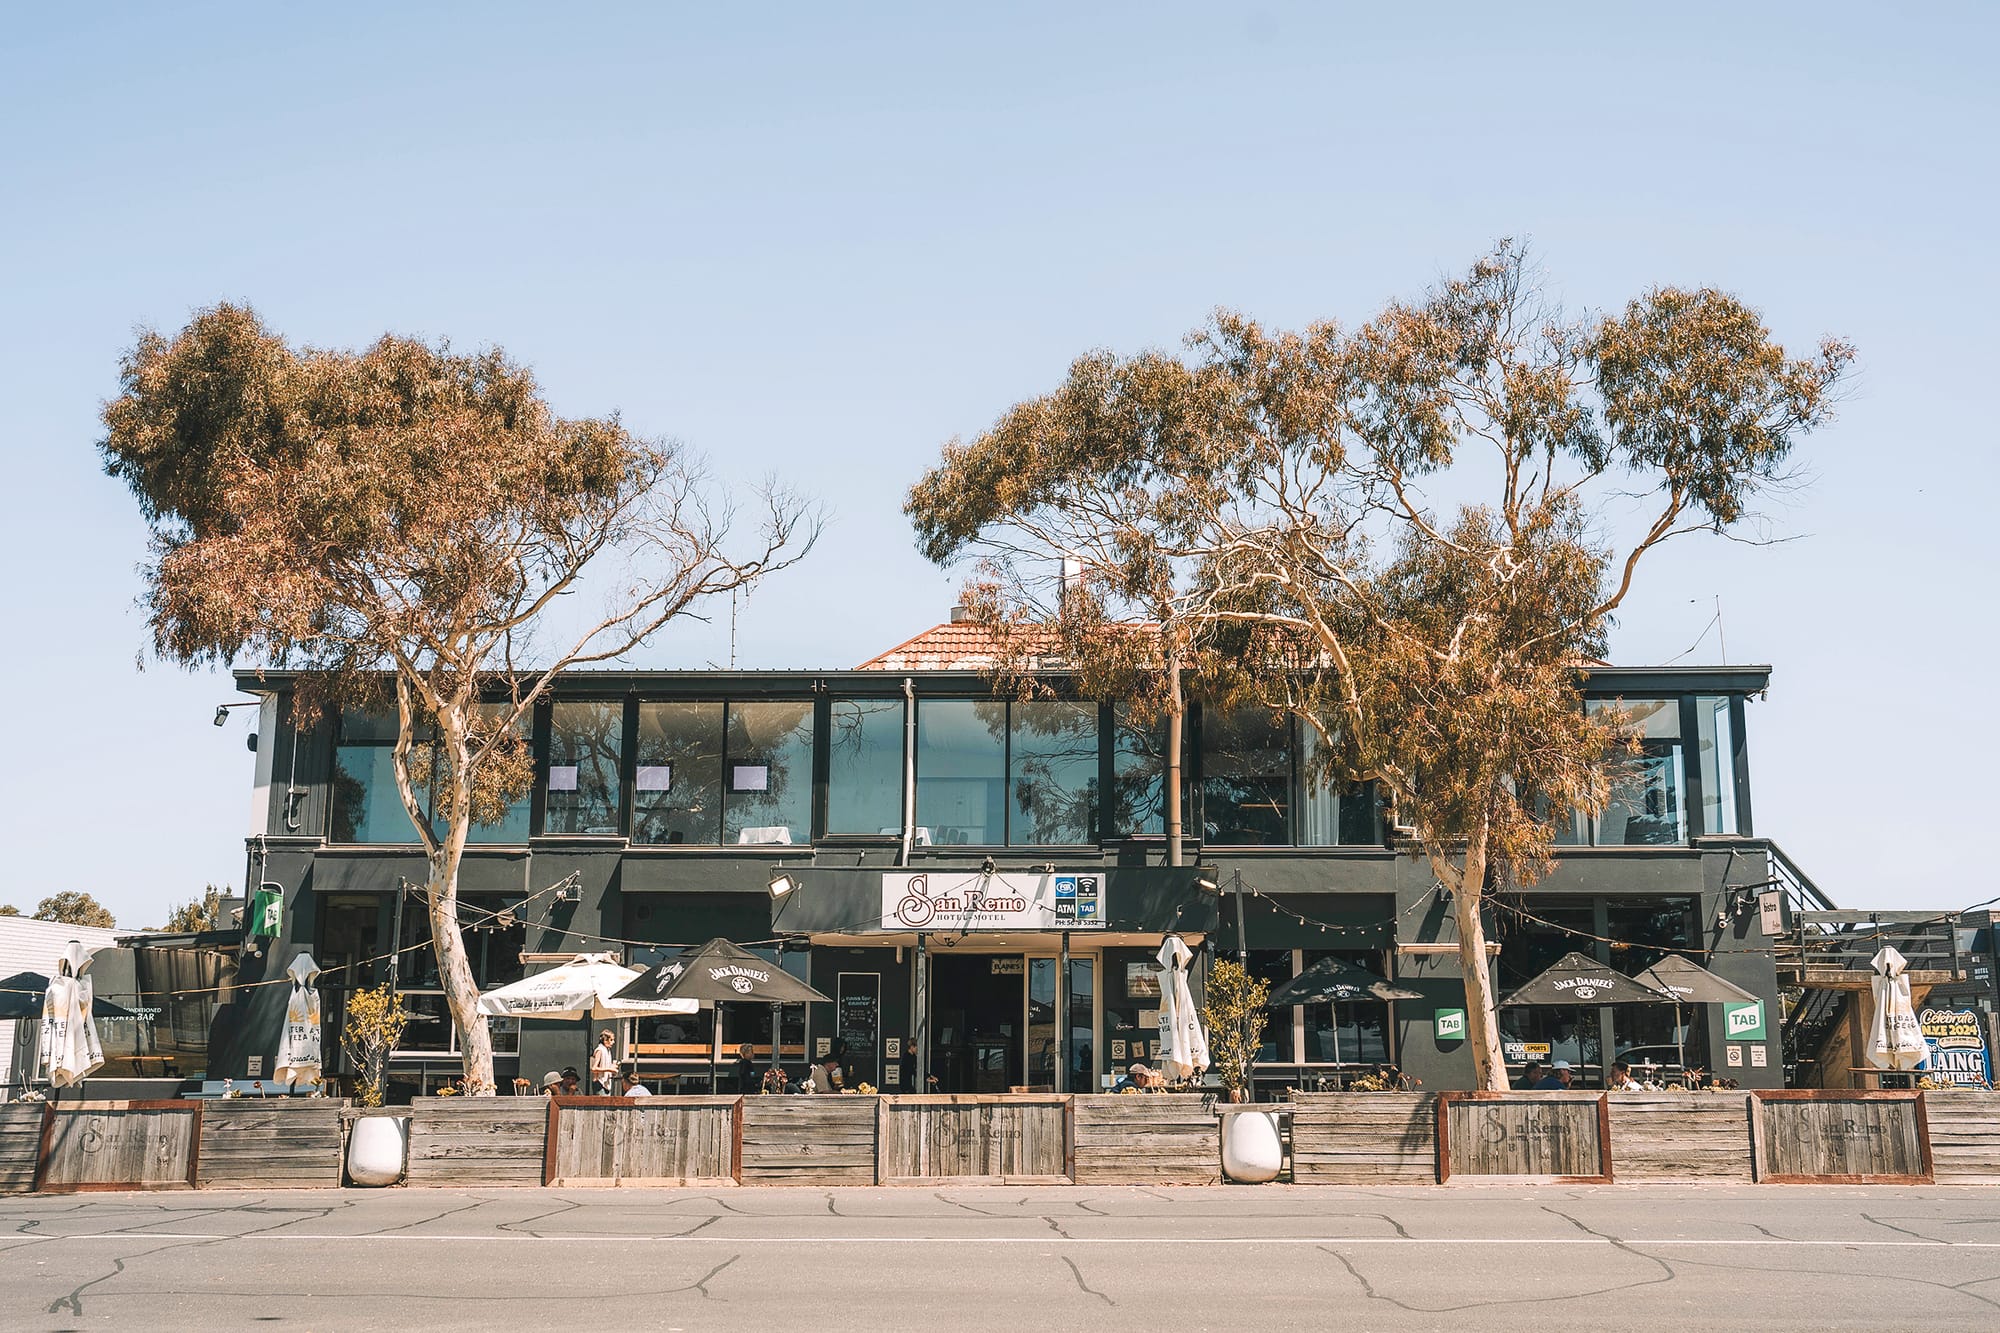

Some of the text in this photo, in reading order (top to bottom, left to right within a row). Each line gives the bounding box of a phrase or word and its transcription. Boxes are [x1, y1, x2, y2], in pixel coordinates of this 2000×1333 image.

[897, 874, 1026, 927] San Remo
[1057, 904, 1075, 914] ATM
[1080, 904, 1095, 913] TAB
[708, 965, 770, 982] JACK DANIEL'S
[1553, 976, 1615, 990] JACK DANIEL'S
[137, 1013, 155, 1021] BAR
[1732, 1015, 1757, 1025] TAB
[1922, 1009, 1975, 1025] Celebrate
[1441, 1020, 1460, 1029] TAB
[1949, 1024, 1977, 1036] 2024
[1506, 1044, 1525, 1052] FOX
[1926, 1053, 1982, 1071] LAING
[1934, 1072, 1983, 1083] ROTHERS
